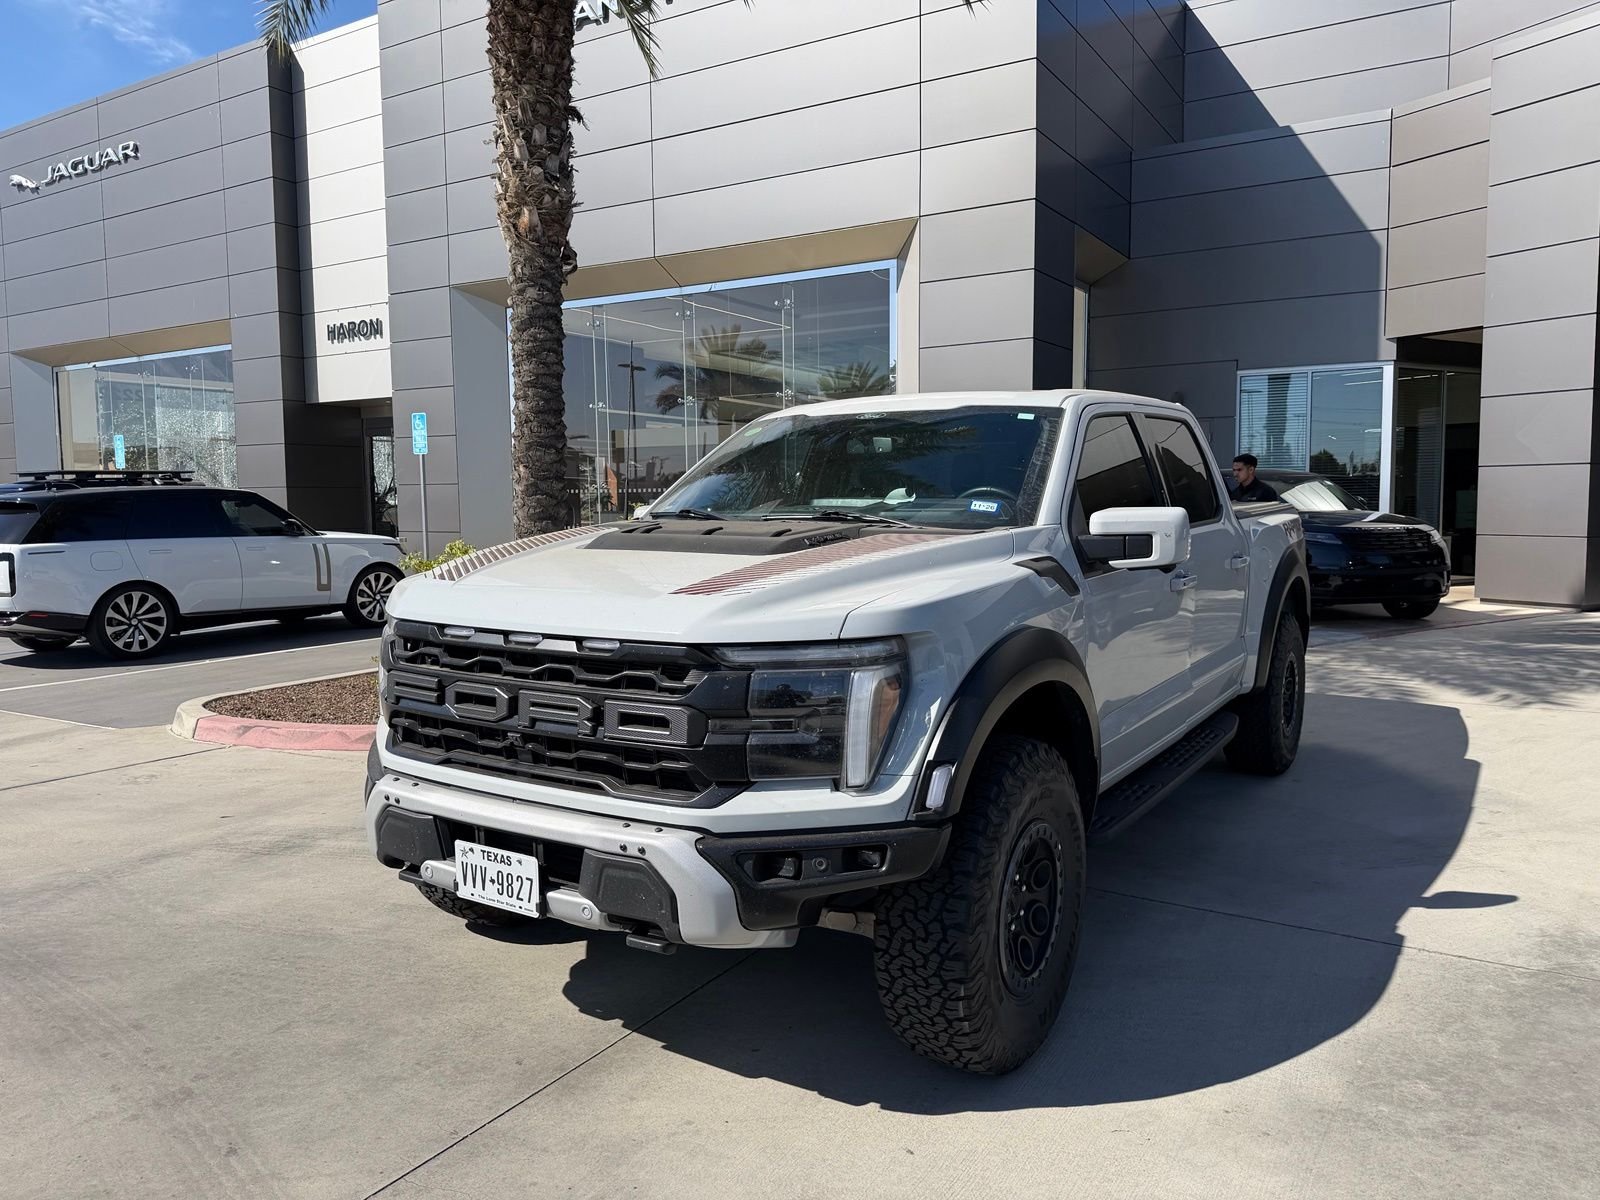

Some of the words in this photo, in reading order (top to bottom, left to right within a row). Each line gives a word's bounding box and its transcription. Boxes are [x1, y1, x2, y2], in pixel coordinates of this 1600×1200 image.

[41, 141, 139, 184] JAGUAR
[327, 318, 381, 343] HARON
[387, 670, 709, 745] FORD
[480, 849, 512, 867] TEXAS
[496, 870, 534, 904] 9827
